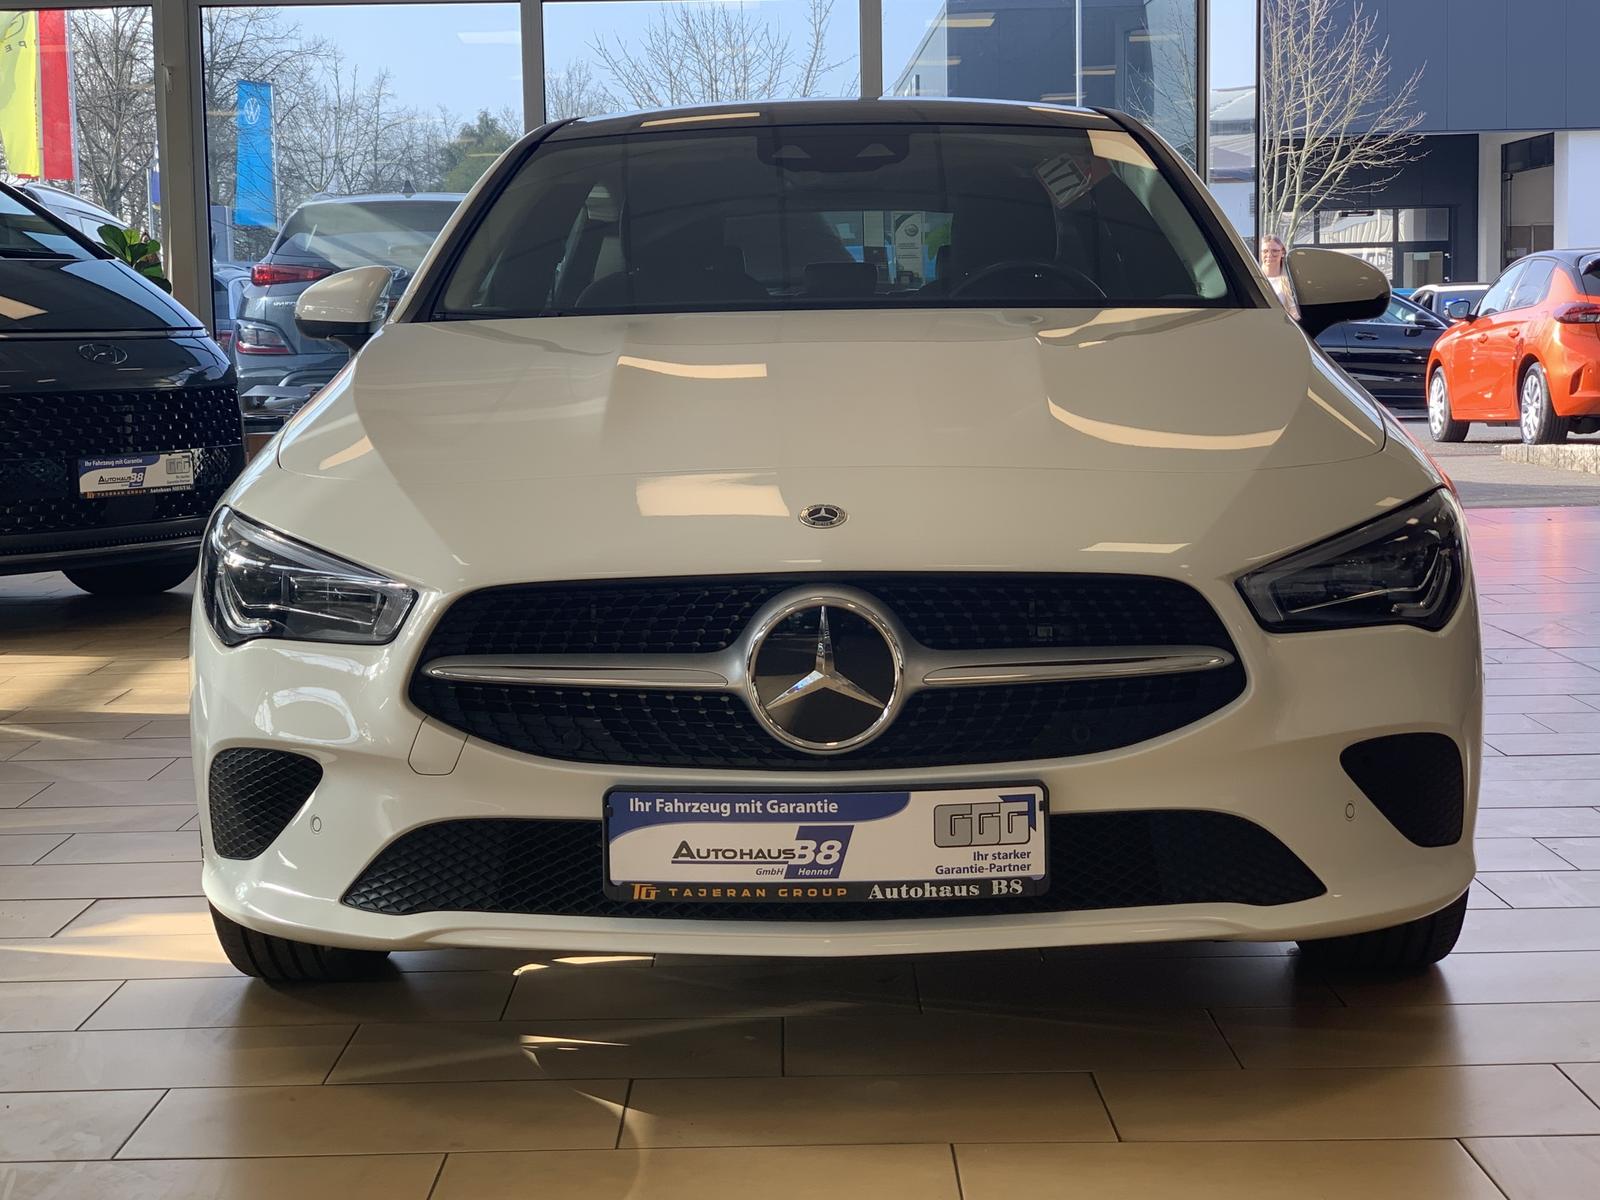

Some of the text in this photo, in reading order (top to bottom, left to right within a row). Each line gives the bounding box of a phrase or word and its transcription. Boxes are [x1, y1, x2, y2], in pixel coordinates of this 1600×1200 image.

[629, 798, 839, 817] Ihr Fahrzeug mit Garantie
[973, 849, 1032, 861] Ihr starker
[755, 867, 834, 876] GmbH Hennef
[935, 863, 1032, 875] Garantie-Partner
[668, 887, 766, 897] TAJERAN
[777, 887, 848, 897] GROUP
[868, 879, 1023, 900] Autohaus B8
